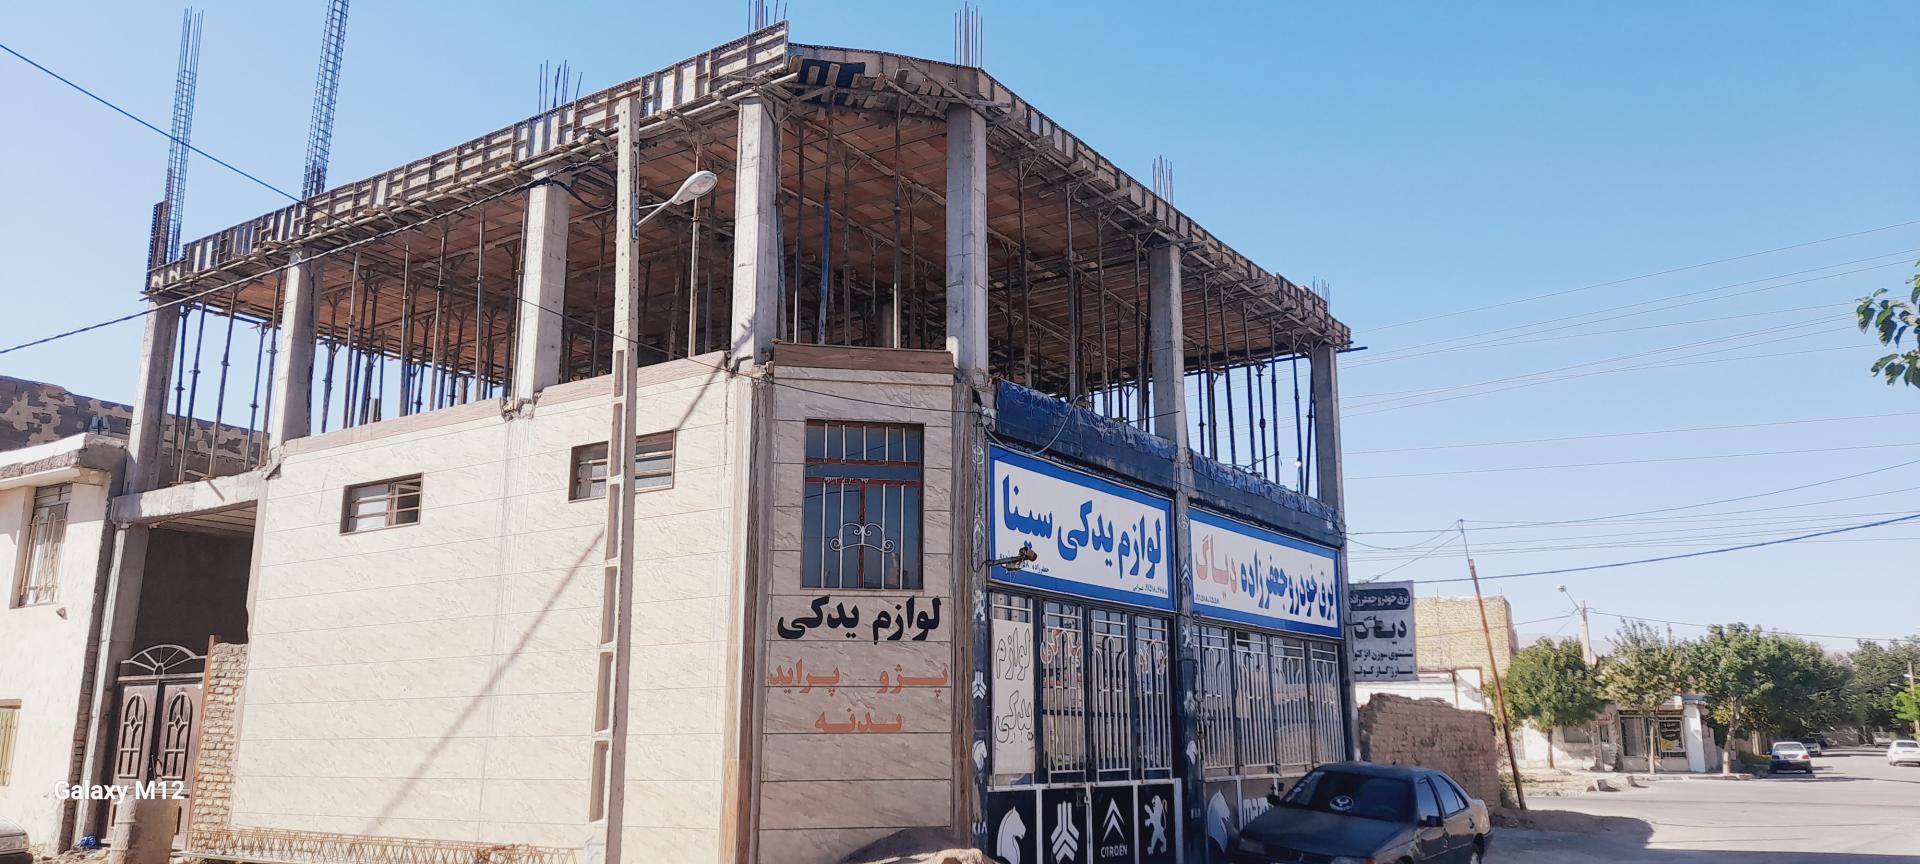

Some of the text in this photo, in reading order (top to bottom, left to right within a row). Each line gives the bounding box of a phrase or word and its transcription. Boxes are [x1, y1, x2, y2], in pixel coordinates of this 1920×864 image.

[1003, 474, 1162, 580] لوازم یدکی سینا
[1195, 534, 1237, 600] دیاگ
[1289, 563, 1318, 618] خودرو
[777, 594, 942, 646] لوازم یدکی
[1319, 570, 1335, 621] برق
[767, 658, 949, 698] پژو پراید
[996, 627, 1031, 681] لوازم
[995, 690, 1034, 743] یدکی
